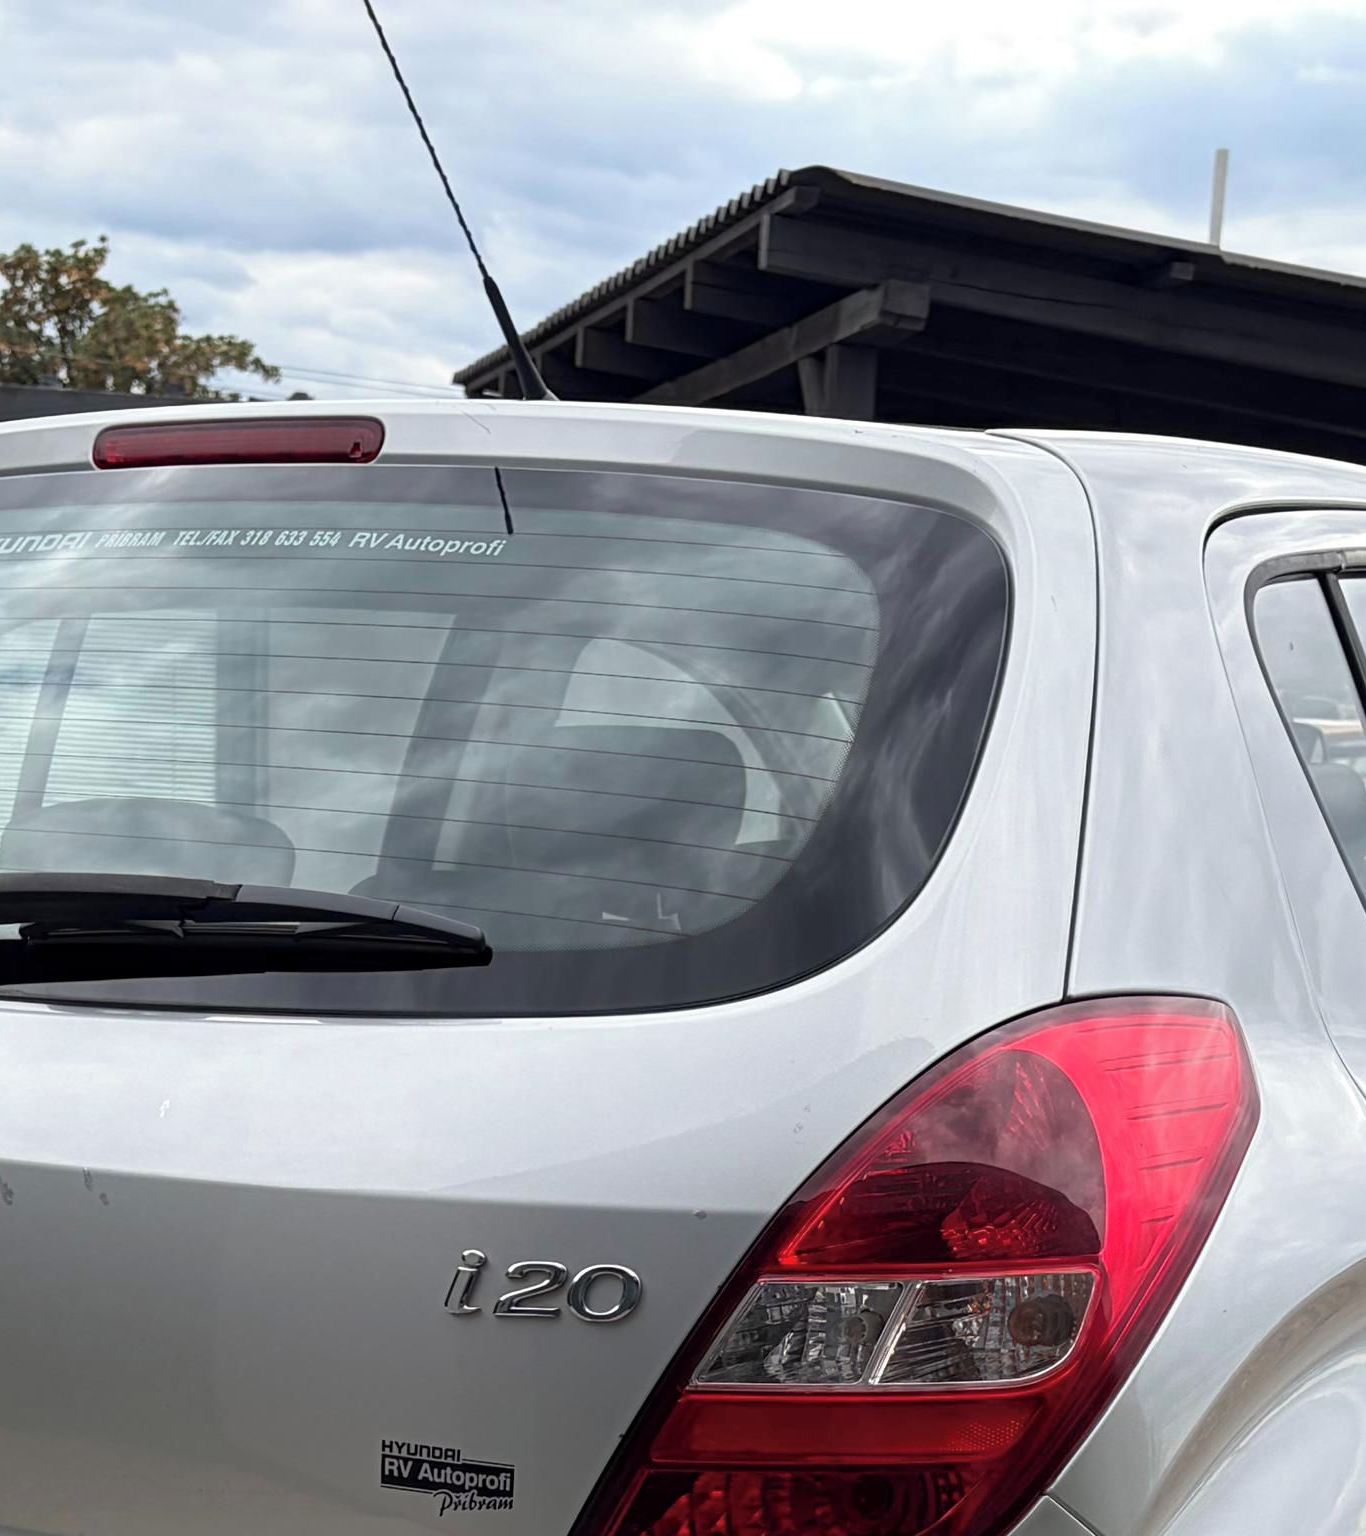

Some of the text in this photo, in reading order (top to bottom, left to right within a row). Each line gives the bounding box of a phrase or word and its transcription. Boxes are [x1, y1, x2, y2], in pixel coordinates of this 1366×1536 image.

[240, 530, 270, 546] 318
[274, 530, 306, 546] 633
[309, 531, 342, 547] 554
[348, 532, 387, 548] RV
[385, 535, 507, 556] Autoprofi
[444, 1249, 643, 1322] i20
[381, 1439, 462, 1462] HYUNDAI
[384, 1457, 512, 1492] RV Autoprofi
